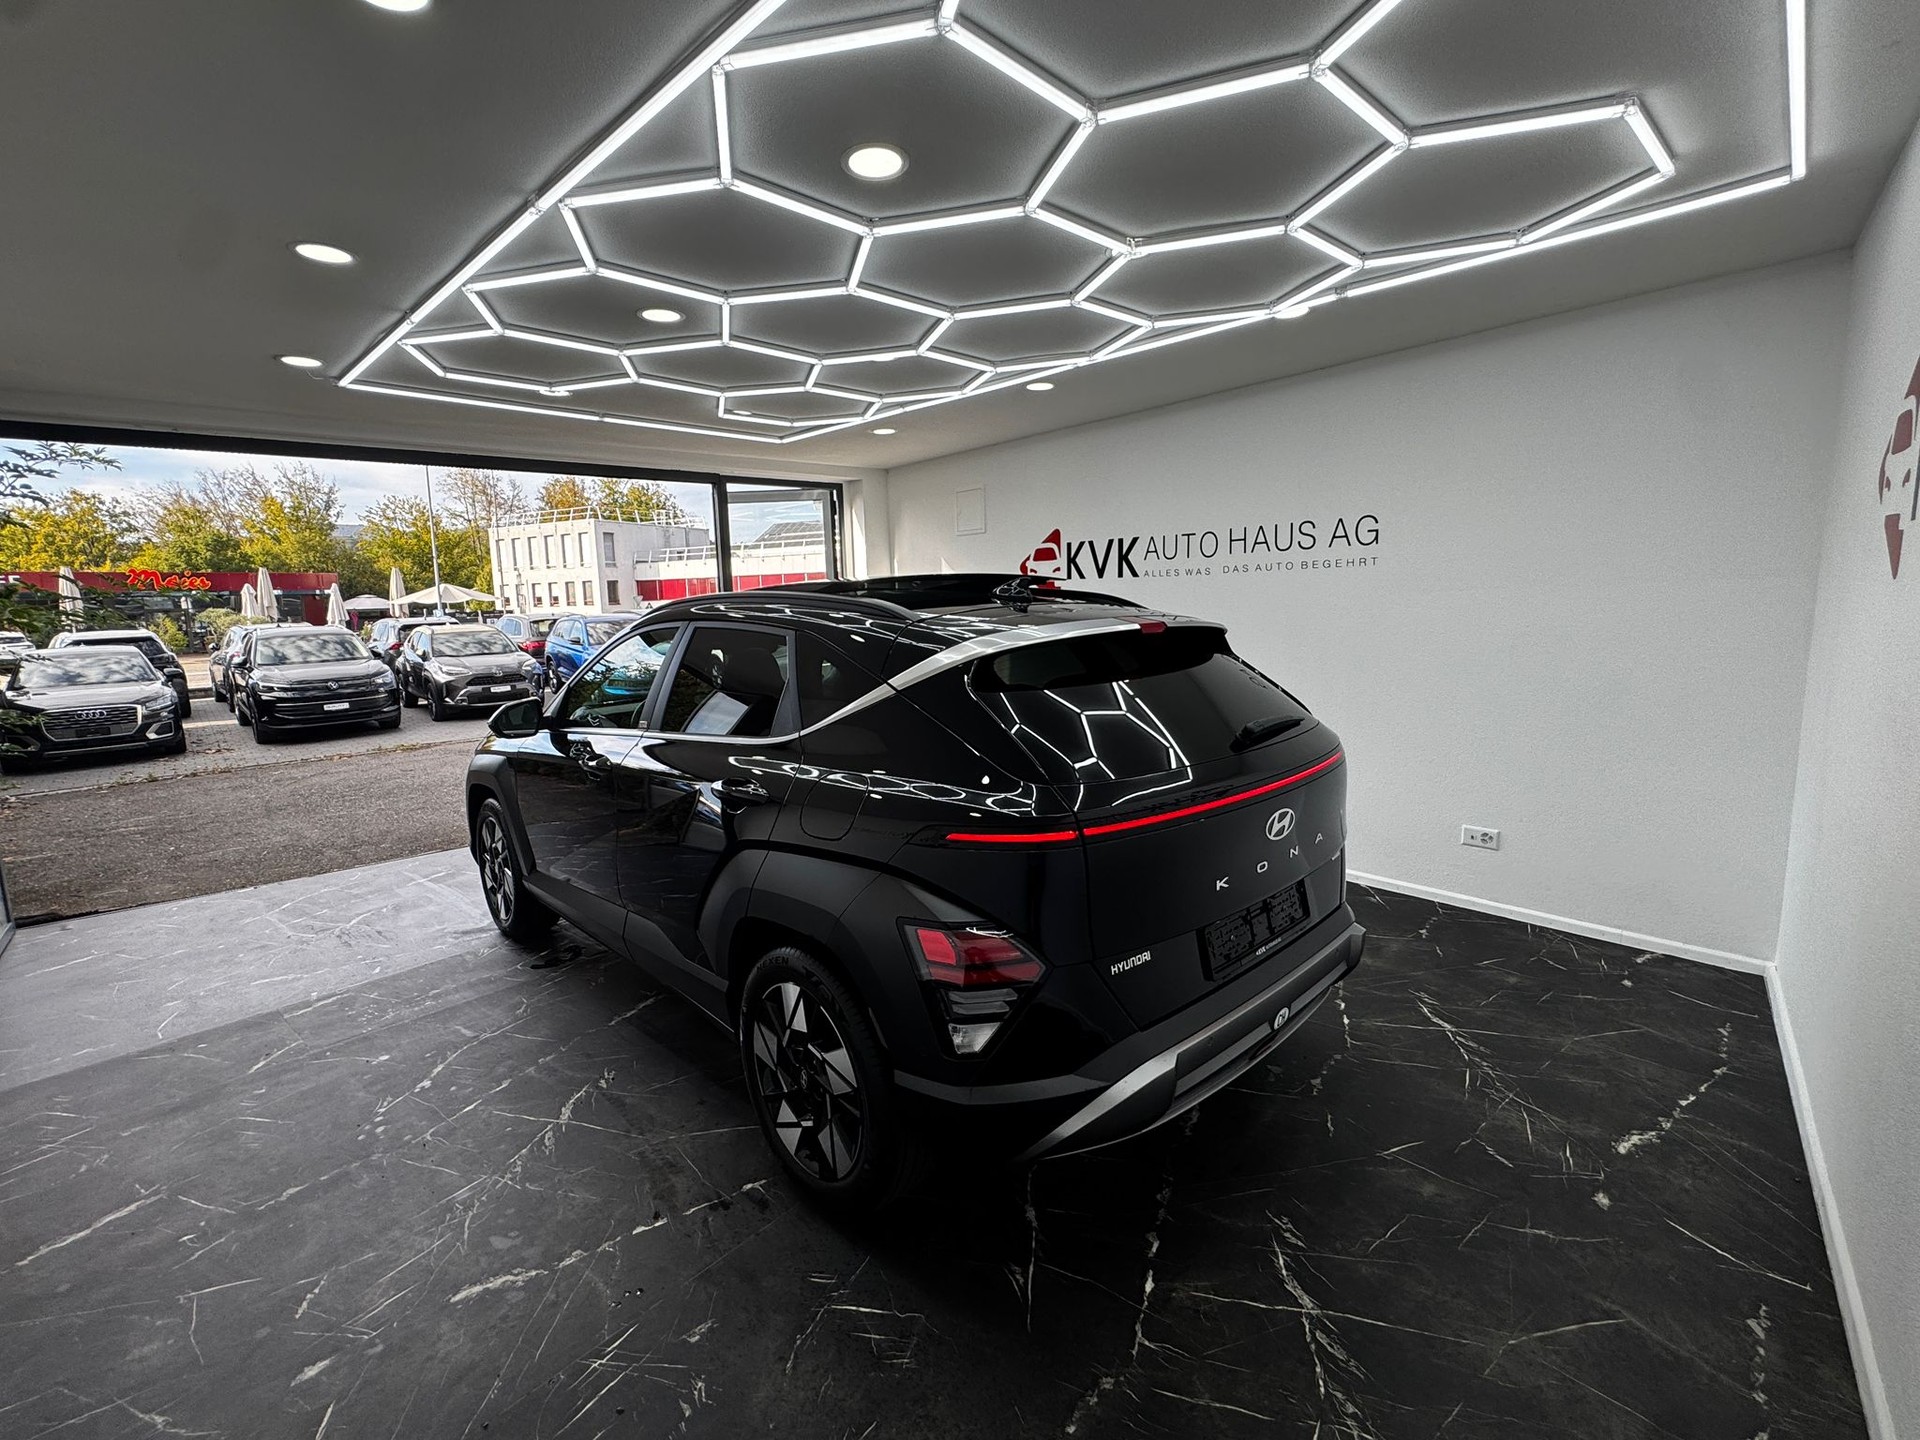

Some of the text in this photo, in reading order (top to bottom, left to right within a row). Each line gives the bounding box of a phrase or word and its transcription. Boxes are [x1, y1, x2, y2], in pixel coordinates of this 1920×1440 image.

[1066, 514, 1379, 579] KVK AUTO HAUS AG
[1143, 557, 1378, 577] ALLES WAS DAS AUTO BEGEHRT
[1215, 832, 1324, 891] KONA
[1110, 950, 1151, 976] HYUNDAI
